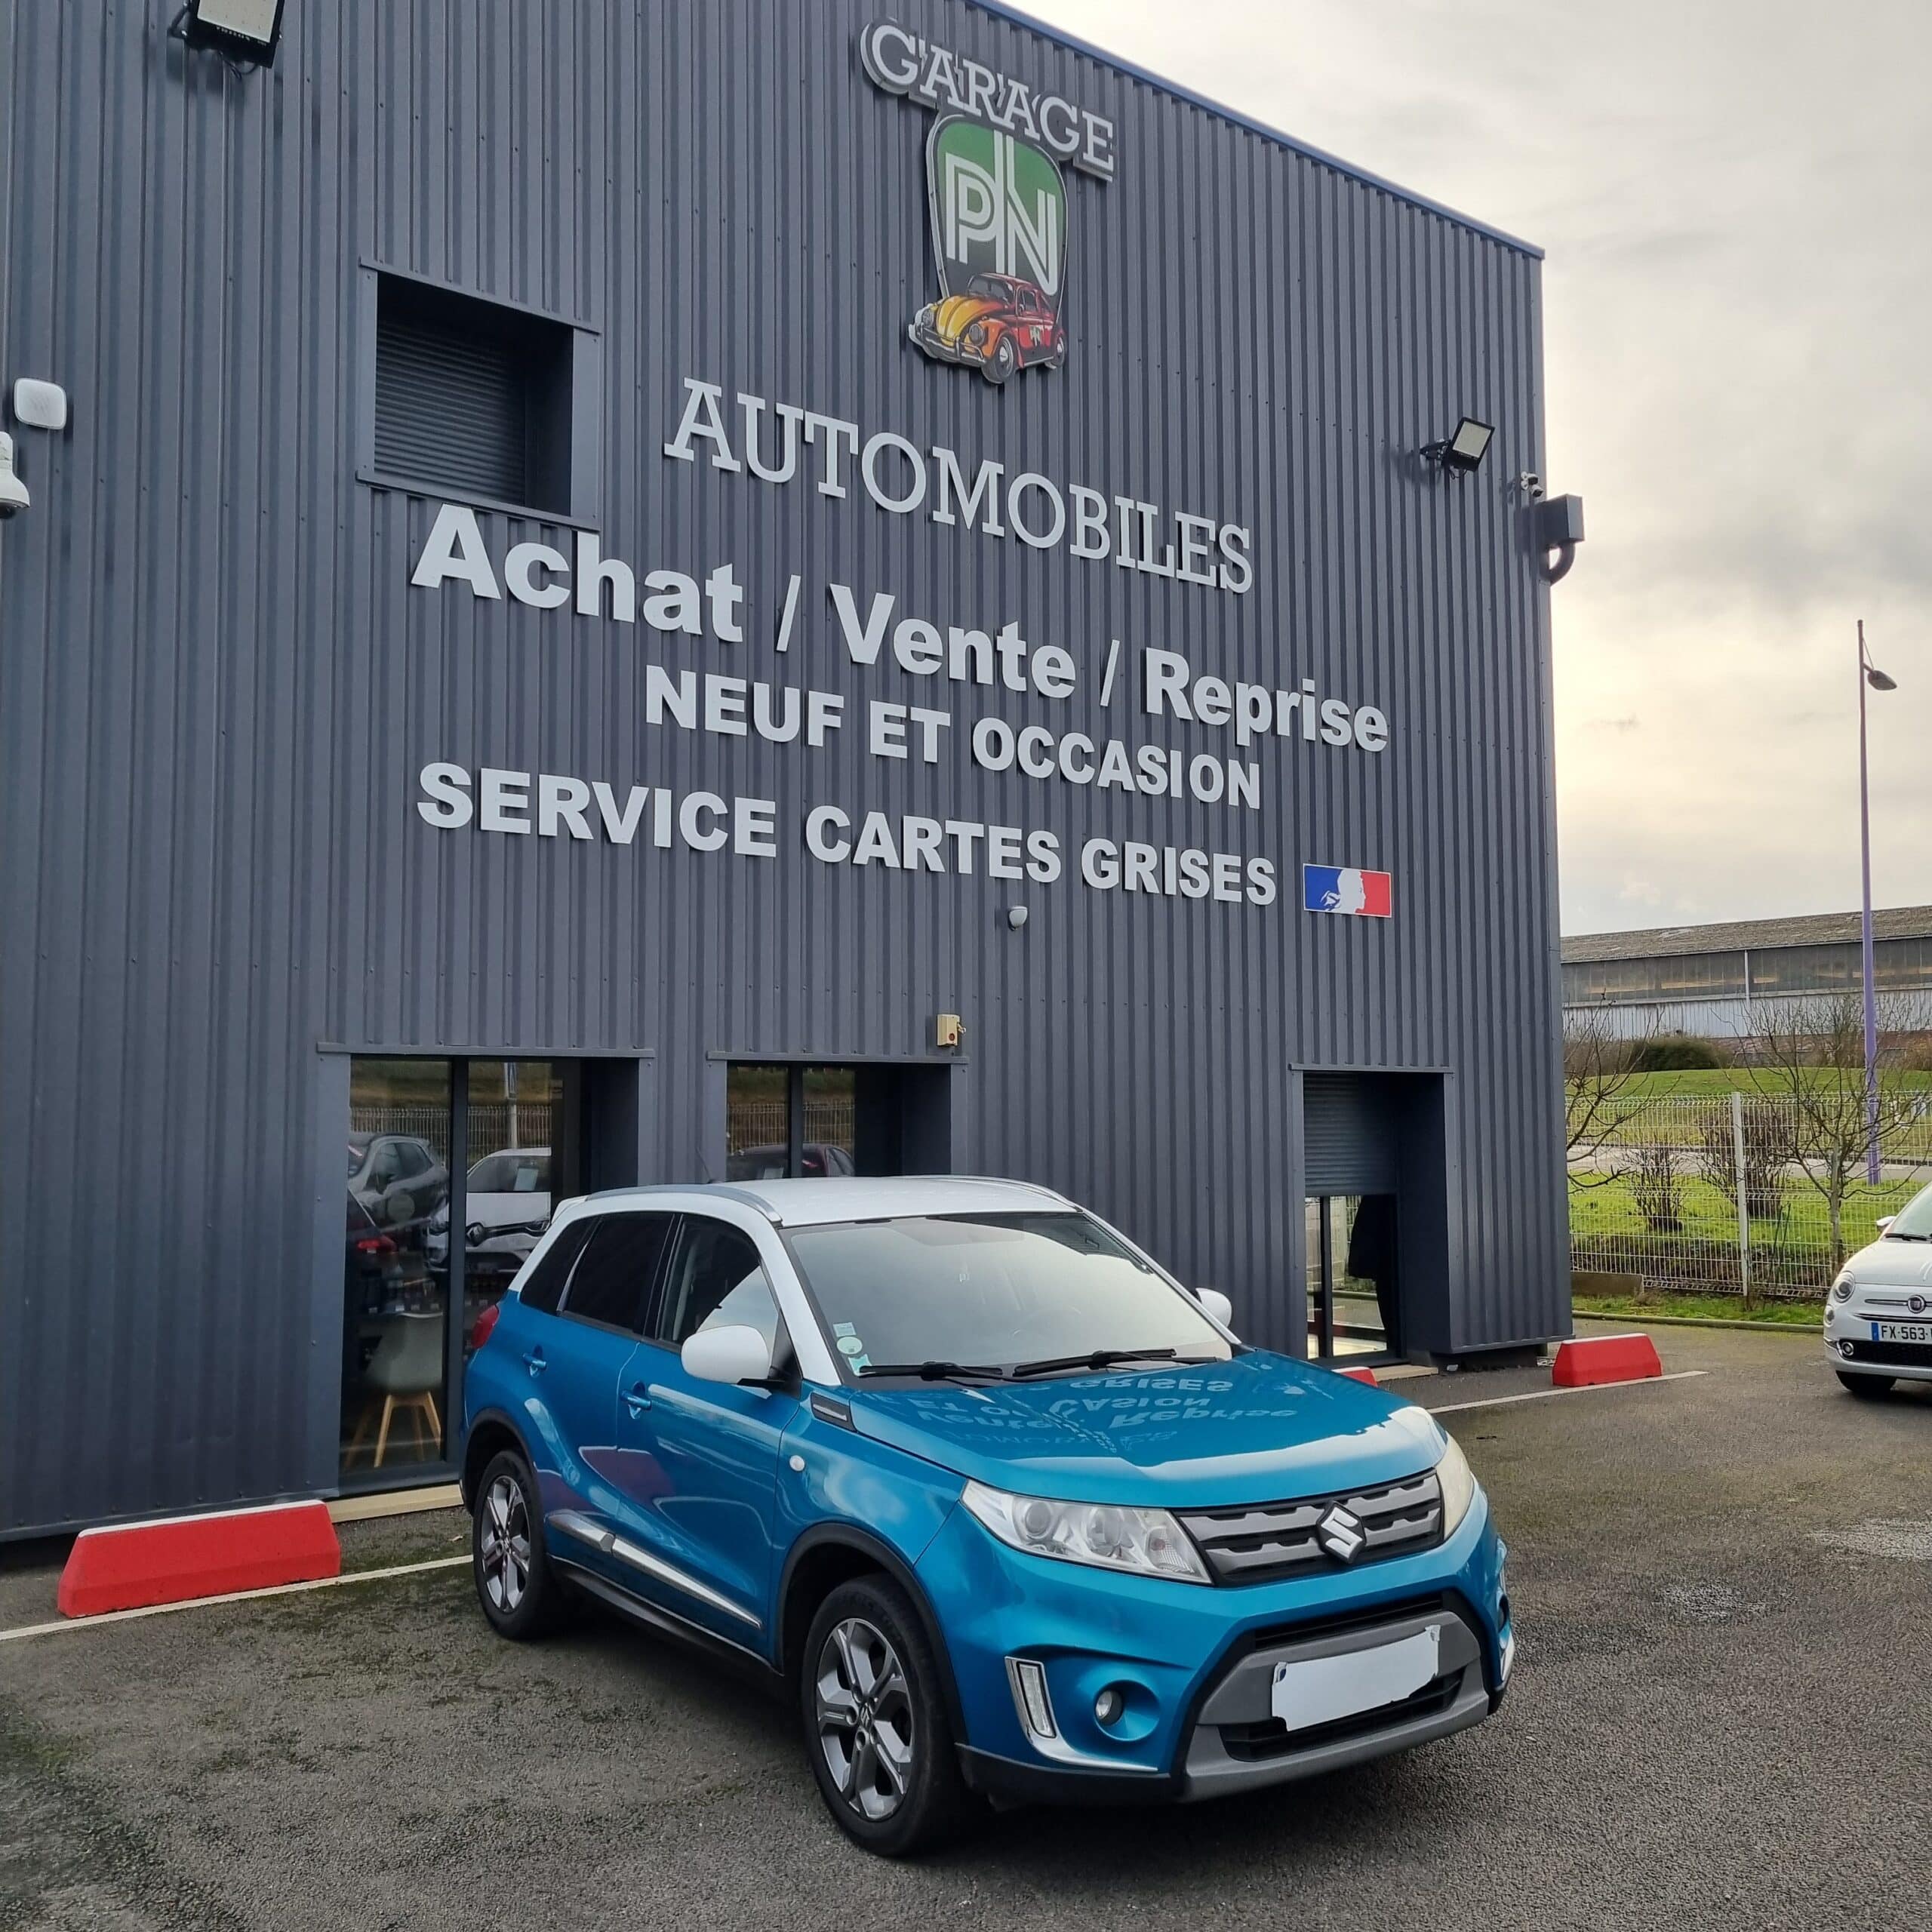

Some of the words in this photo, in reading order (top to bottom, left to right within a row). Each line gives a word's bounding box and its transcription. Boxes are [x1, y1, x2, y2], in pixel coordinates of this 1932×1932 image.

[872, 24, 1114, 173] GARAGE
[664, 377, 1254, 595] AUTOMOBILES
[411, 503, 743, 643] Achat
[829, 583, 1076, 699] Vente
[1146, 647, 1389, 752] Reprise
[646, 664, 844, 747] NEUF
[870, 700, 951, 764] ET
[973, 717, 1260, 810] OCCASION
[417, 762, 777, 858] SERVICE
[805, 804, 1061, 883] CARTES
[1081, 838, 1277, 906] GRISES
